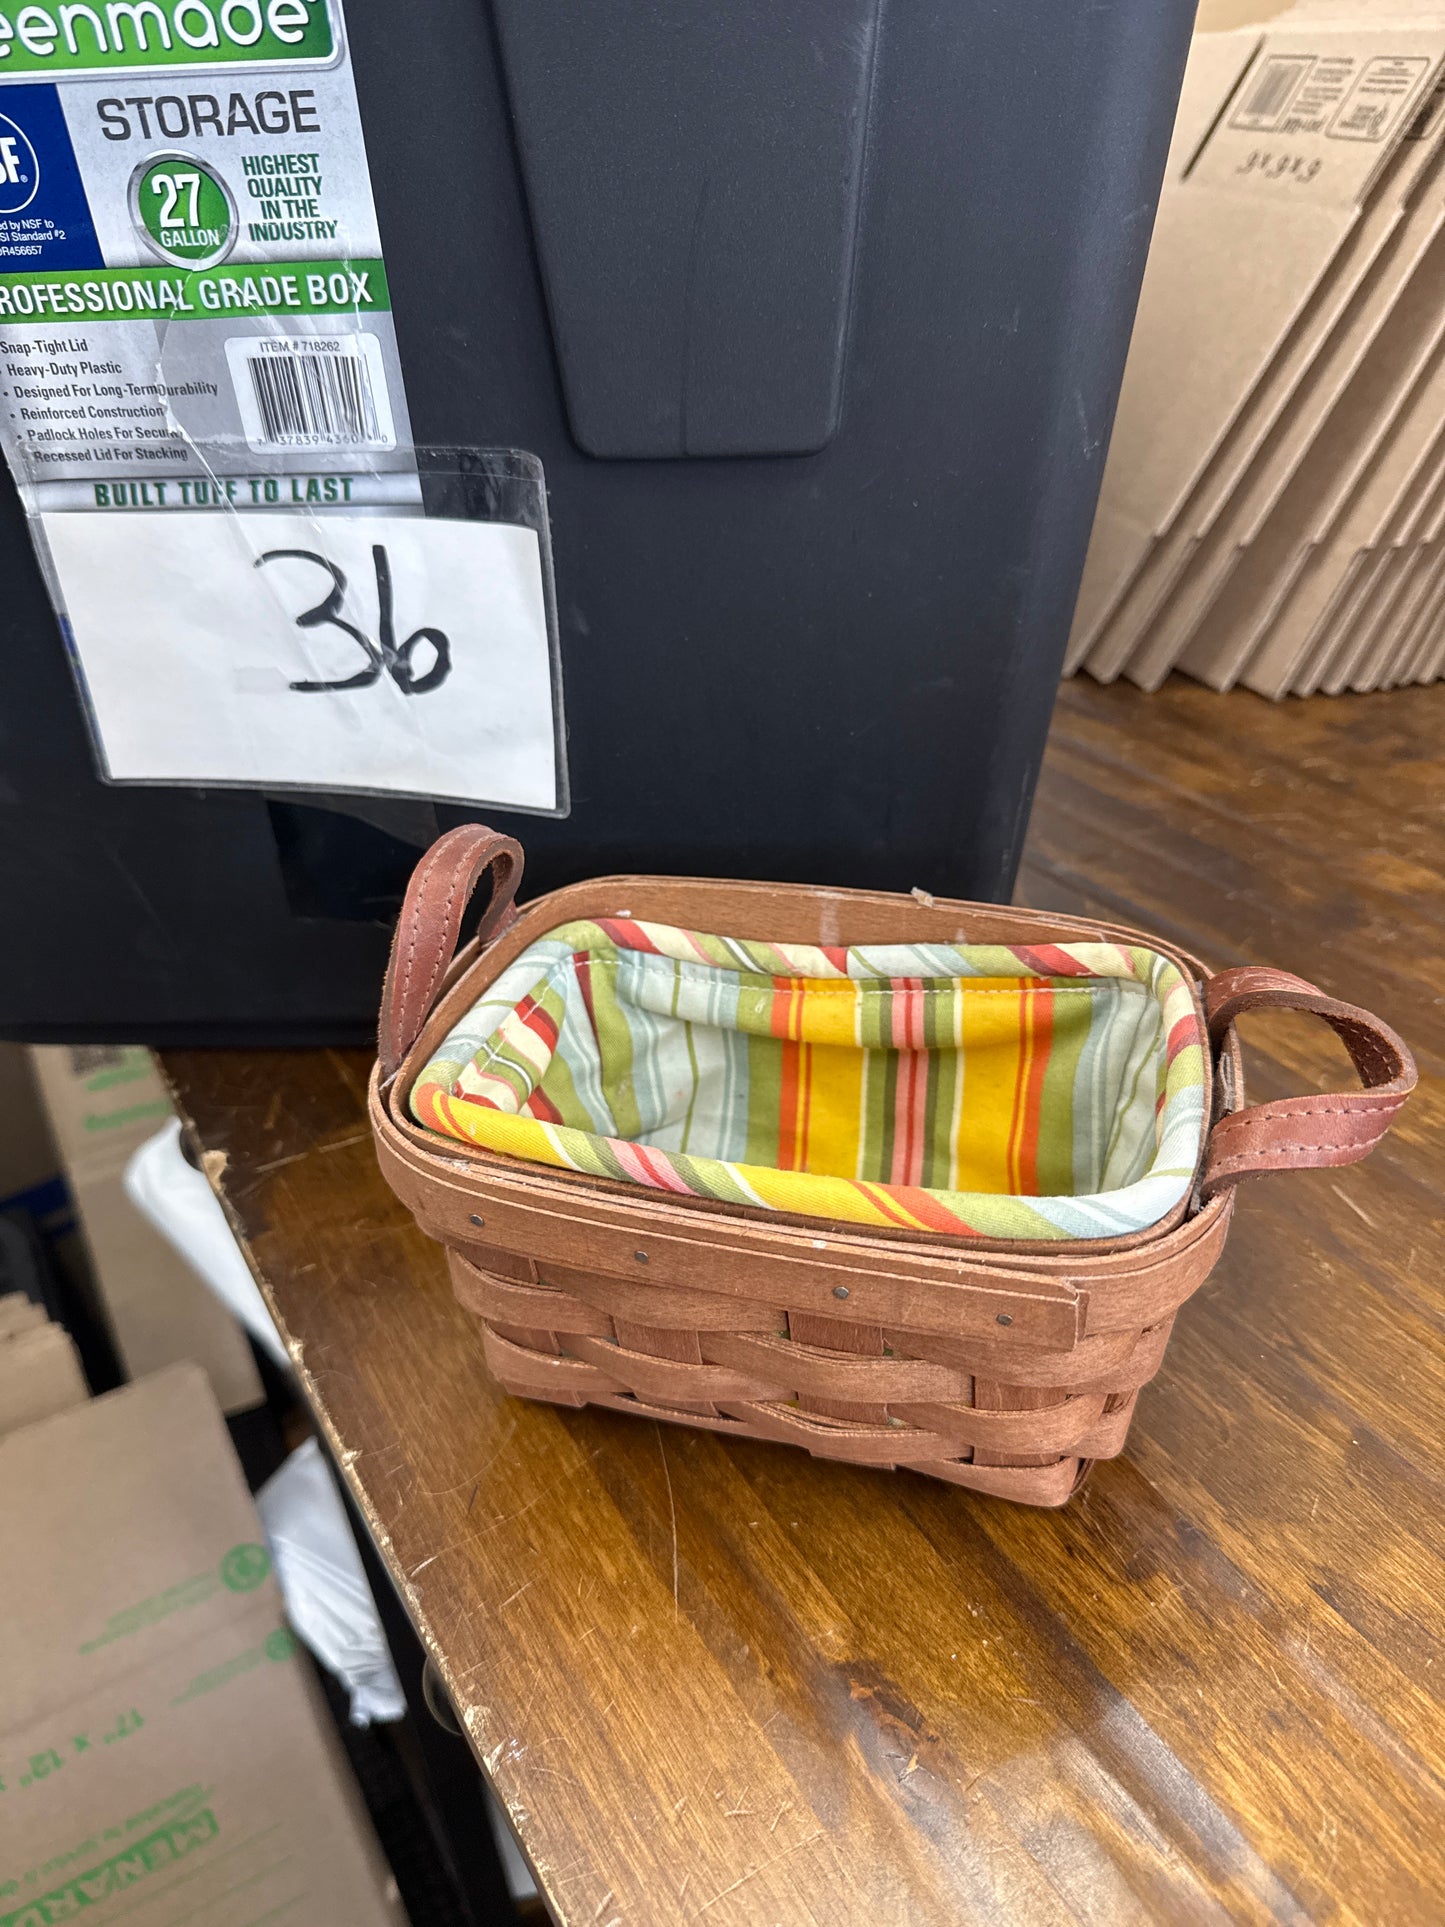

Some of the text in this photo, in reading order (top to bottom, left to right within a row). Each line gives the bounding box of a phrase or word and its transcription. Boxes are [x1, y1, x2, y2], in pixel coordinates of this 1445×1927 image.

[97, 90, 321, 141] STORAGE
[241, 153, 320, 176] HIGHEST
[248, 176, 323, 198] QUALITY
[152, 173, 201, 229] 27
[261, 198, 321, 220] IN THE
[9, 220, 20, 232] by
[21, 218, 42, 229] NSF
[44, 219, 55, 229] to
[249, 220, 338, 242] INDUSTRY
[11, 230, 53, 241] Standard
[161, 229, 221, 248] GALLON
[199, 276, 301, 311] GRADE
[306, 272, 374, 306] BOX
[0, 338, 88, 357] Snap-Tight Lid
[260, 341, 290, 353] ITEM
[301, 340, 341, 352] 718262
[6, 361, 122, 379] Heavy-Duty Plastic
[14, 381, 218, 401] Designed For Long-Term Durability
[20, 404, 165, 420] Reinforced Construction
[27, 427, 76, 441] Padlock
[78, 427, 113, 440] Holes
[113, 426, 133, 439] For
[280, 435, 319, 446] 37839
[33, 446, 188, 463] Recessed Lid For Stacking
[94, 477, 353, 507] BUILT TUFF TO LAST
